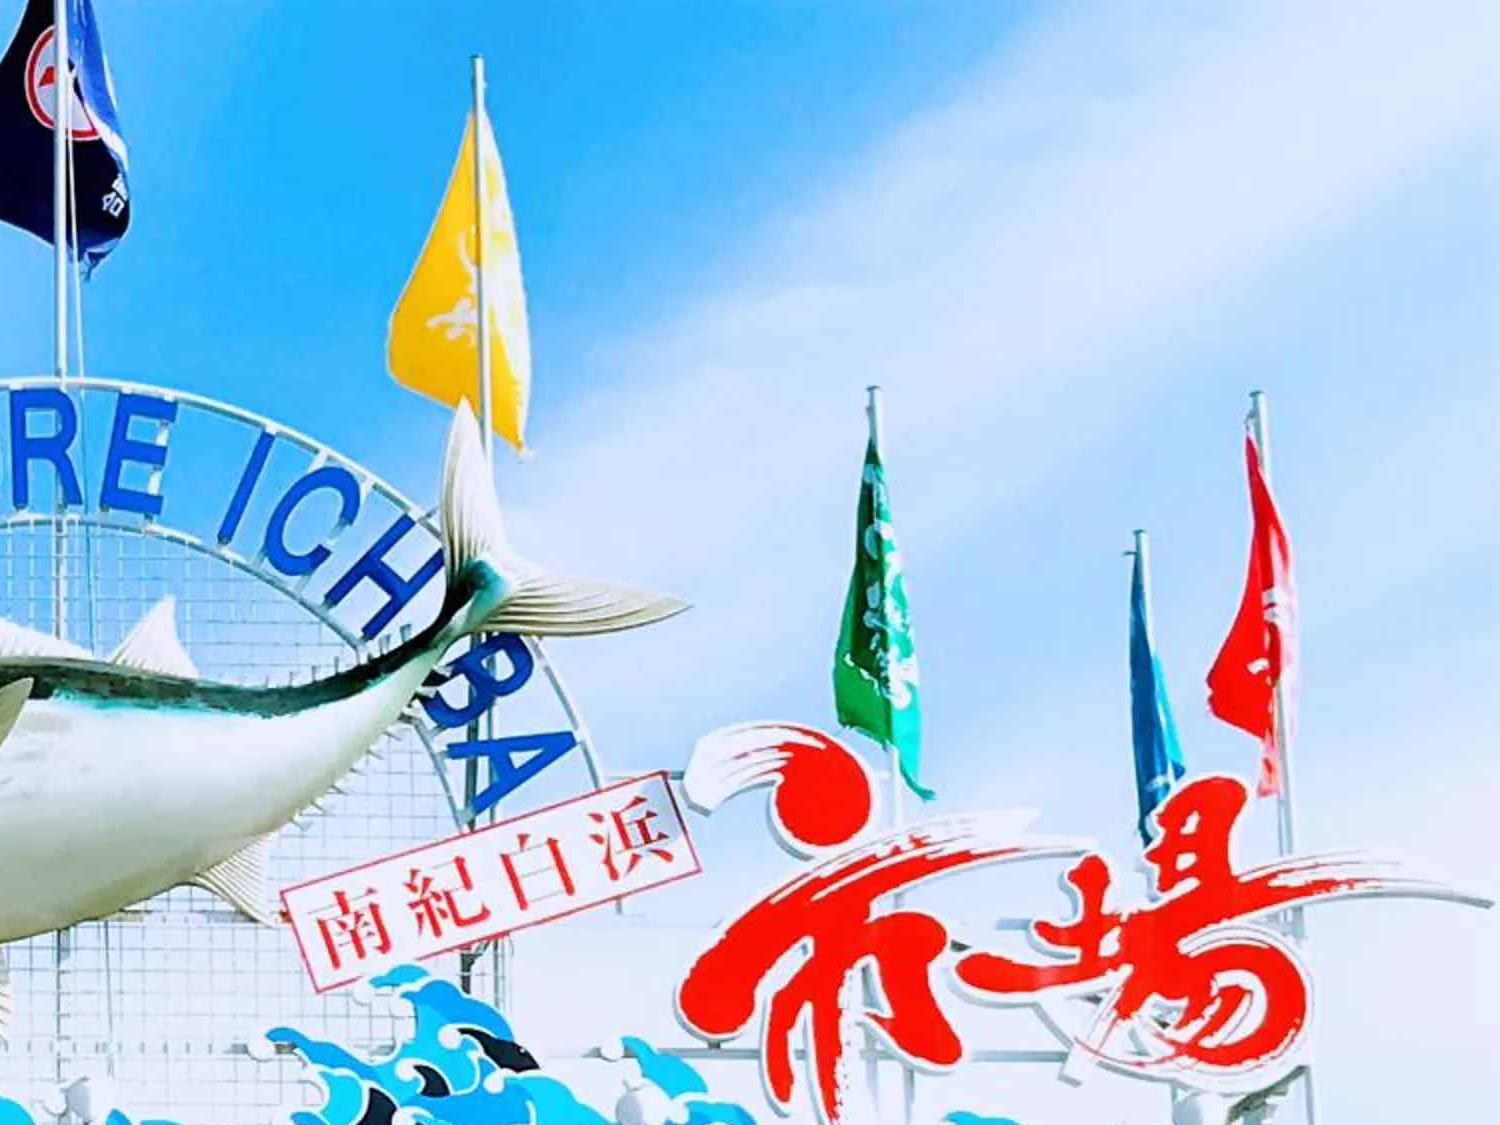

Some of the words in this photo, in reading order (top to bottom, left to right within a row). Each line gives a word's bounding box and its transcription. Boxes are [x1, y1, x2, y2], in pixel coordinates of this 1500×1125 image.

[217, 431, 577, 816] ICHBA
[308, 795, 674, 971] 南紀白浜
